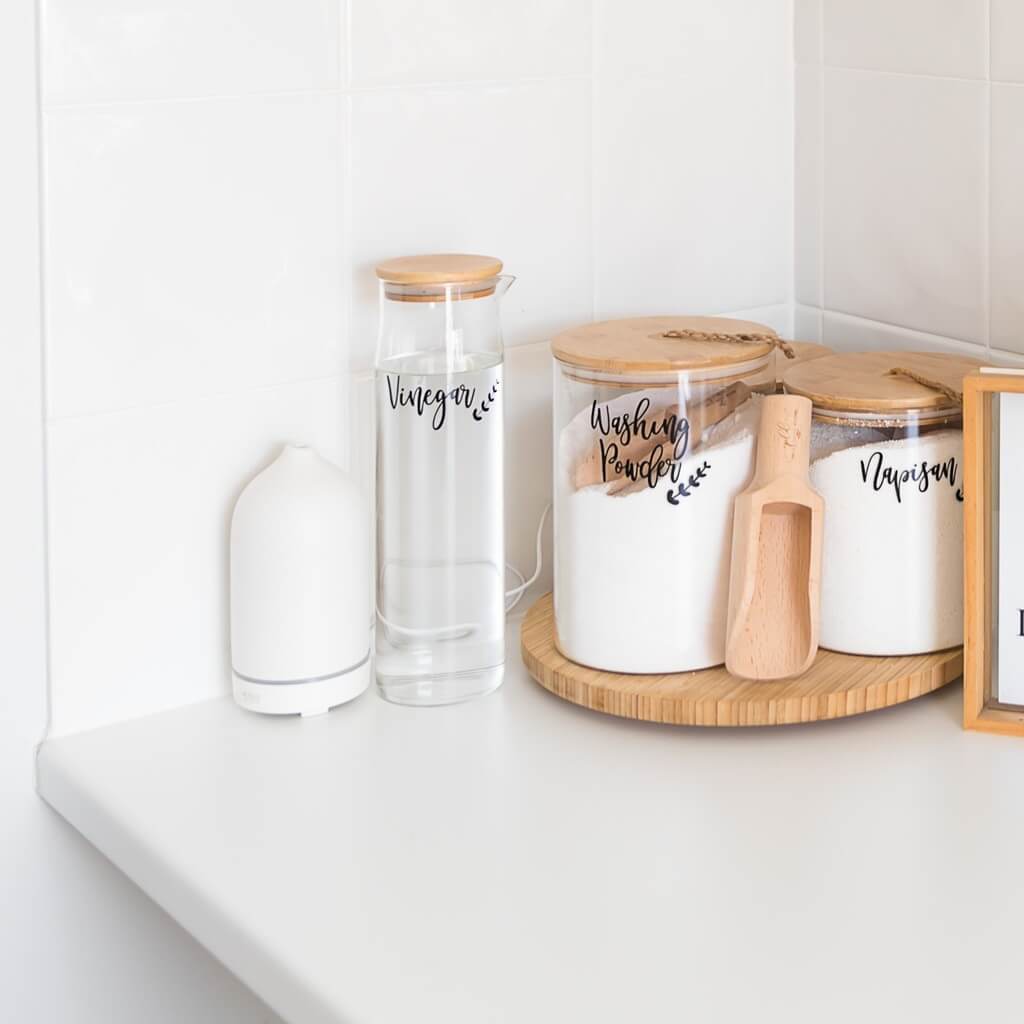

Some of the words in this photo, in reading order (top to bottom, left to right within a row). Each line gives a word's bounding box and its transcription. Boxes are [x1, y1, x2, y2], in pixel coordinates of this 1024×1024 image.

[386, 375, 476, 430] Vinegar
[590, 397, 690, 461] Washing
[600, 438, 683, 488] Powder
[860, 451, 958, 503] Napisan
